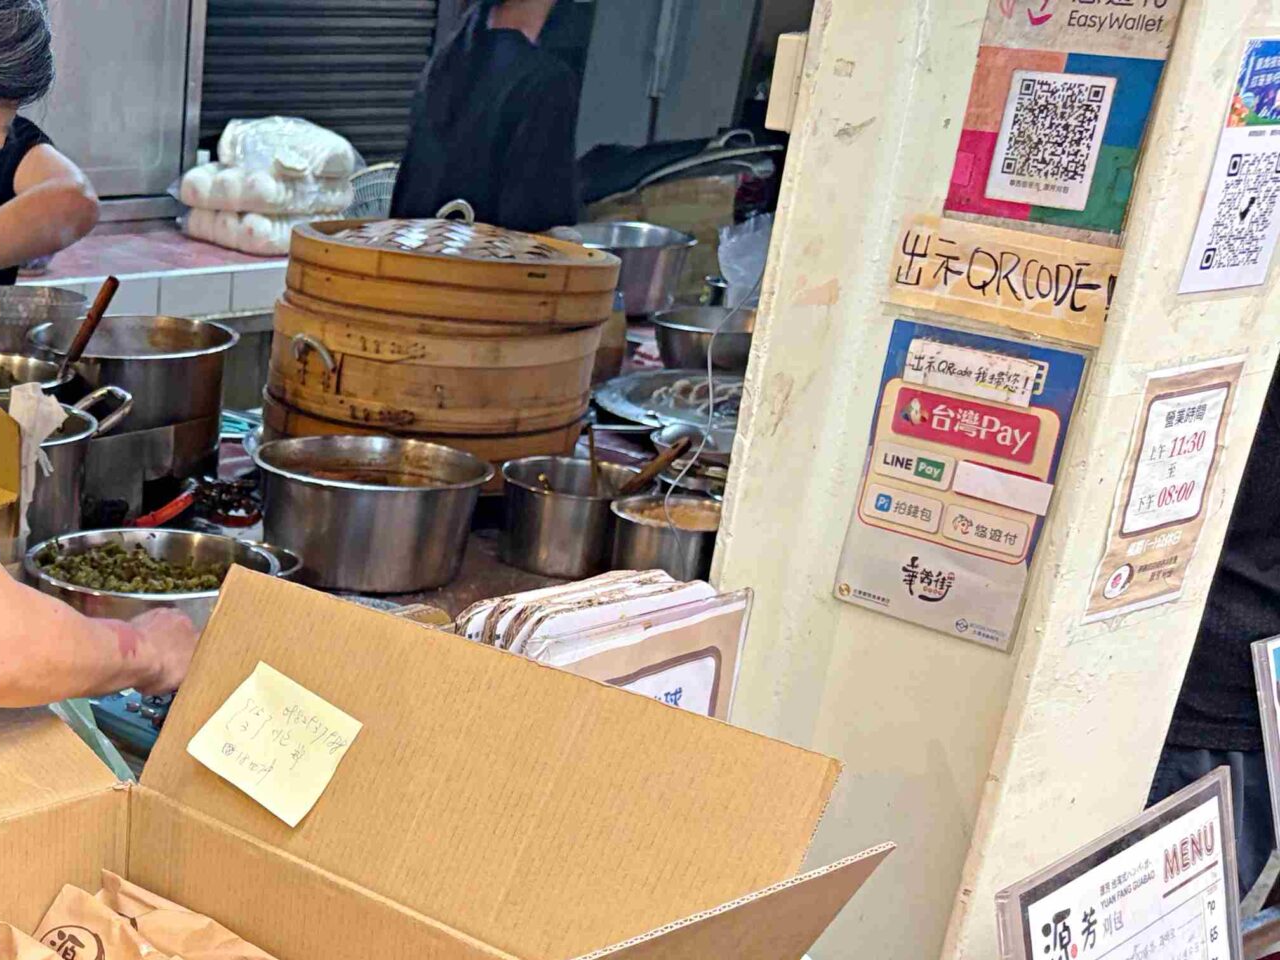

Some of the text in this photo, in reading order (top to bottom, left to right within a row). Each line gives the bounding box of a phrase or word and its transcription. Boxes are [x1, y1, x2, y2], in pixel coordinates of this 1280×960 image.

[1067, 10, 1164, 32] EasyWallet
[931, 404, 1032, 455] 台灣Pay
[1168, 430, 1206, 459] 11:30
[882, 452, 942, 478] LINE Pay
[1157, 480, 1195, 508] 08:00
[893, 500, 932, 522] 拍錢包
[974, 524, 1018, 546] 悠遊付
[1163, 821, 1215, 883] MENU
